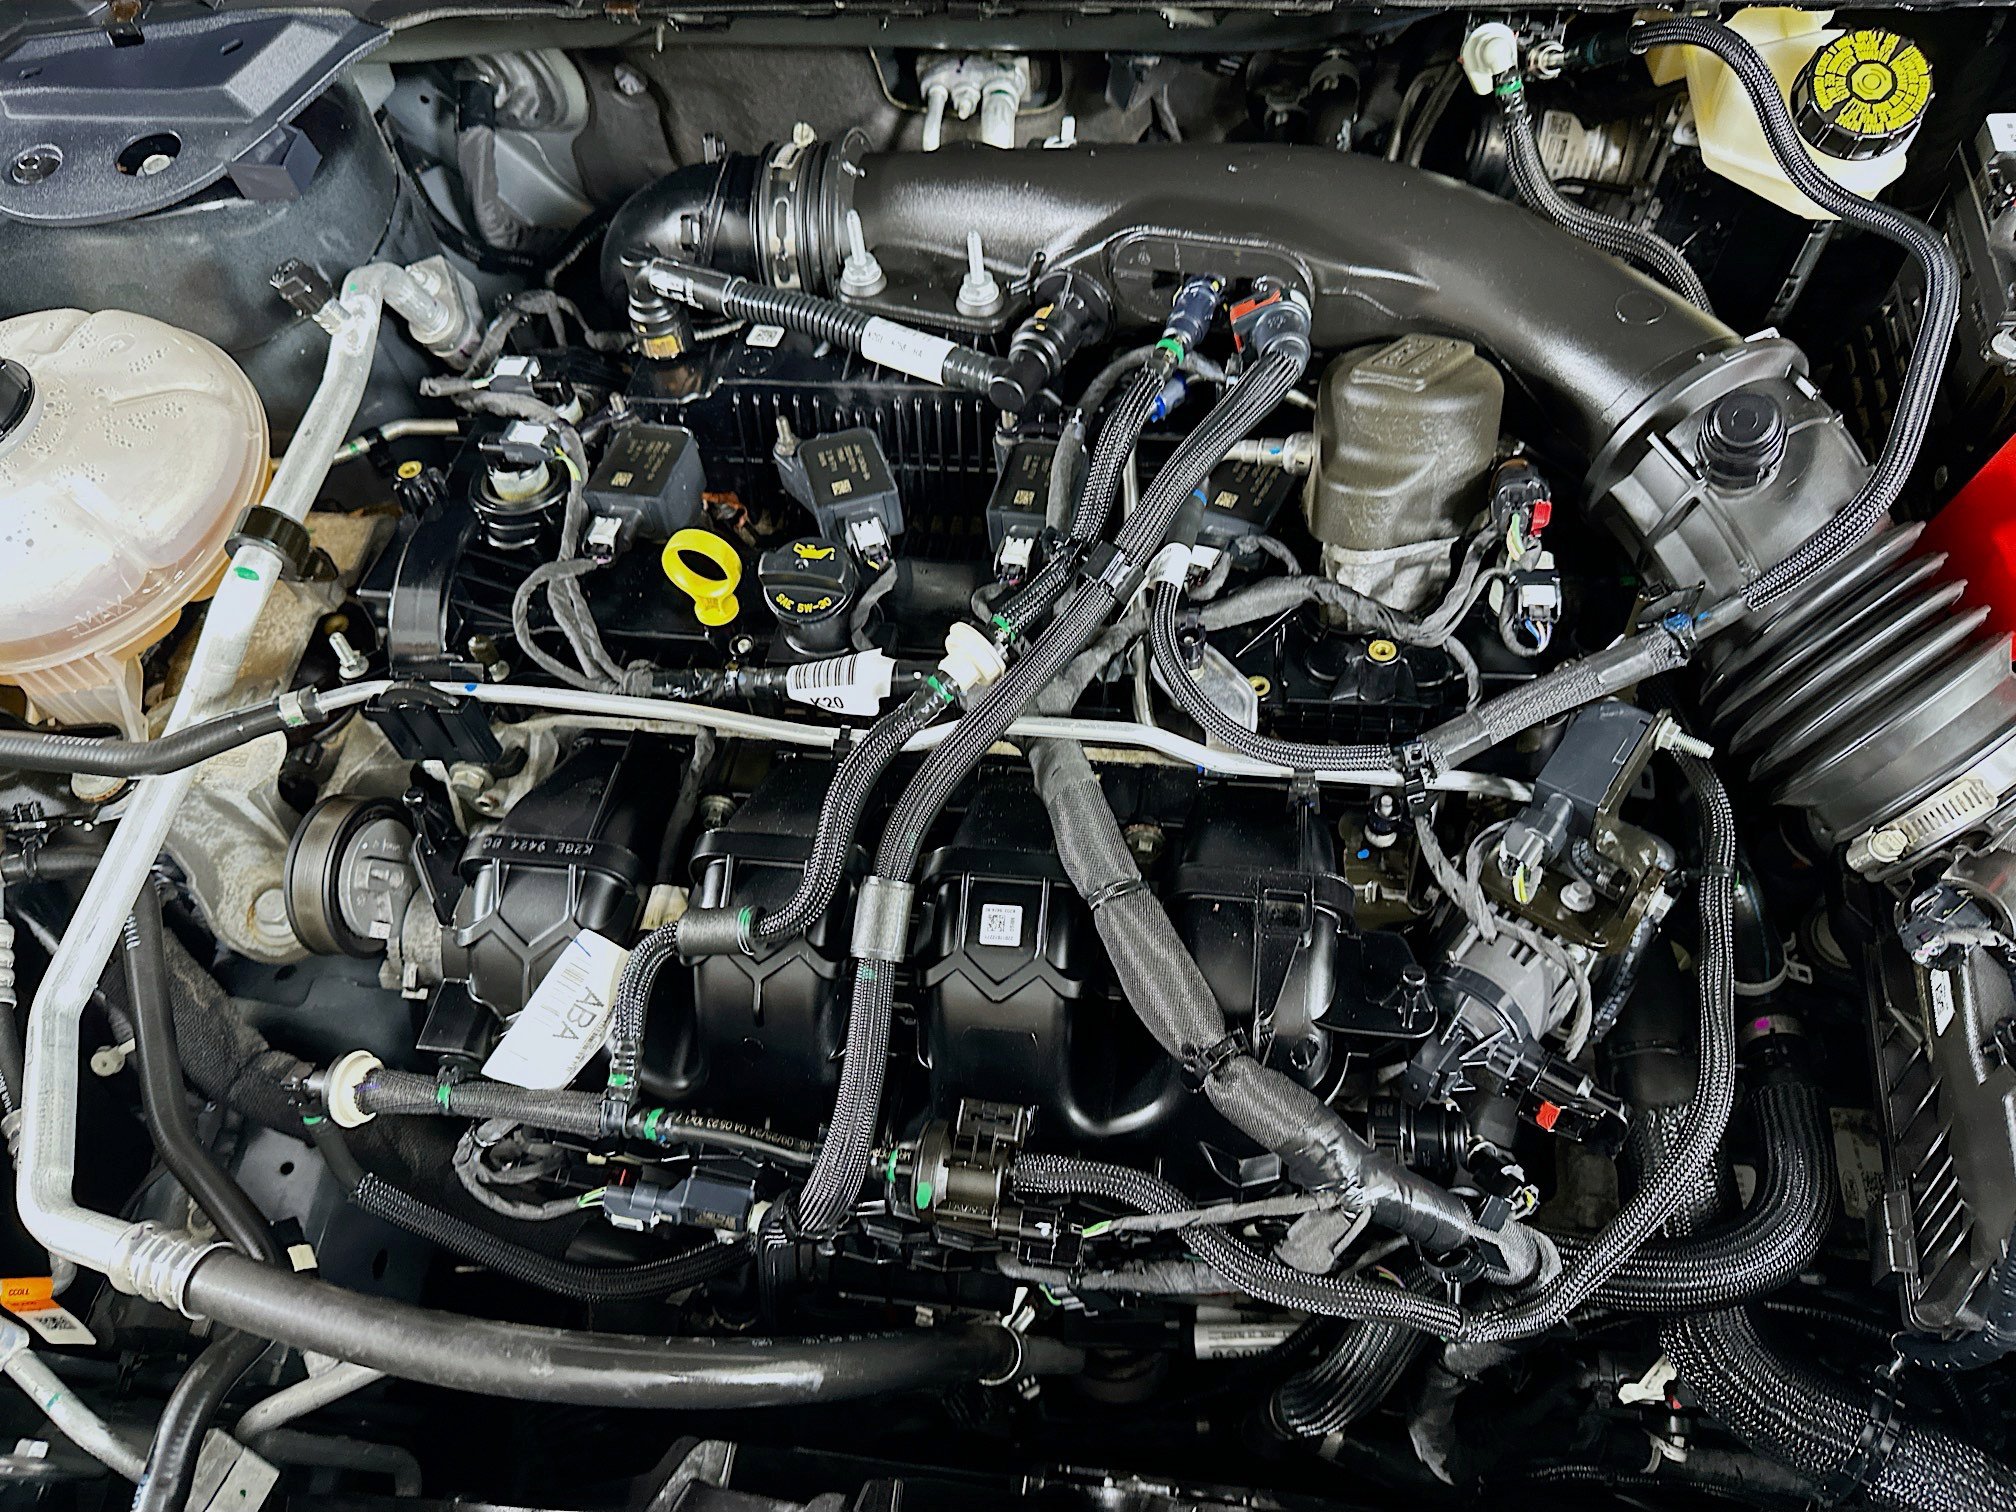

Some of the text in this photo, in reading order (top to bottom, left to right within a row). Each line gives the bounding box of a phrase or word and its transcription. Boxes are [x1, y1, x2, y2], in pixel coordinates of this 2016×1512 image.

[776, 593, 832, 613] SAE 5W-30
[553, 986, 605, 1040] ABA
